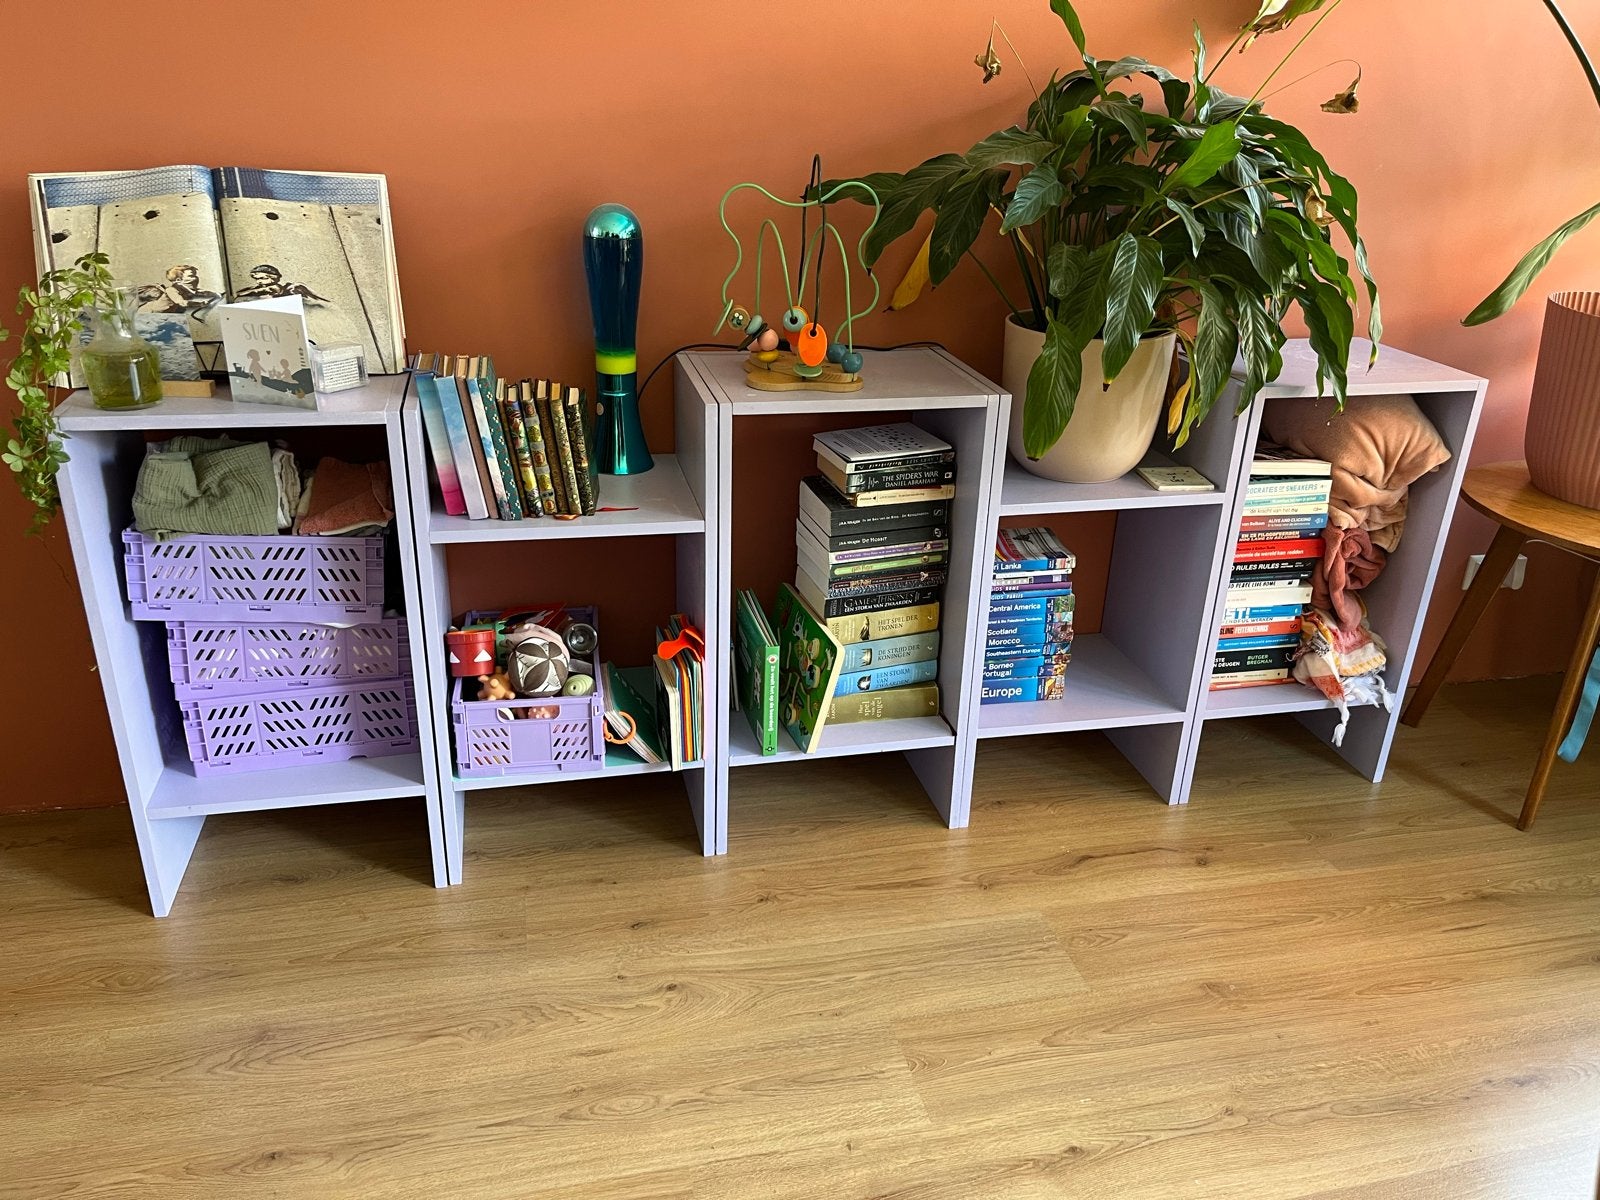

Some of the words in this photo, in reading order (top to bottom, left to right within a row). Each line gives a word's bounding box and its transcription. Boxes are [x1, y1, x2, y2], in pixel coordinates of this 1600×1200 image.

[242, 322, 280, 343] SVEN
[896, 472, 922, 480] SPIDER'S
[1247, 486, 1278, 494] SOCRATES
[844, 598, 870, 607] GAME
[988, 628, 1018, 636] Scotland
[877, 652, 911, 660] KONINGEN
[889, 668, 910, 676] STORM
[982, 688, 1022, 698] Europe
[862, 701, 871, 716] spel
[874, 697, 883, 718] engel
